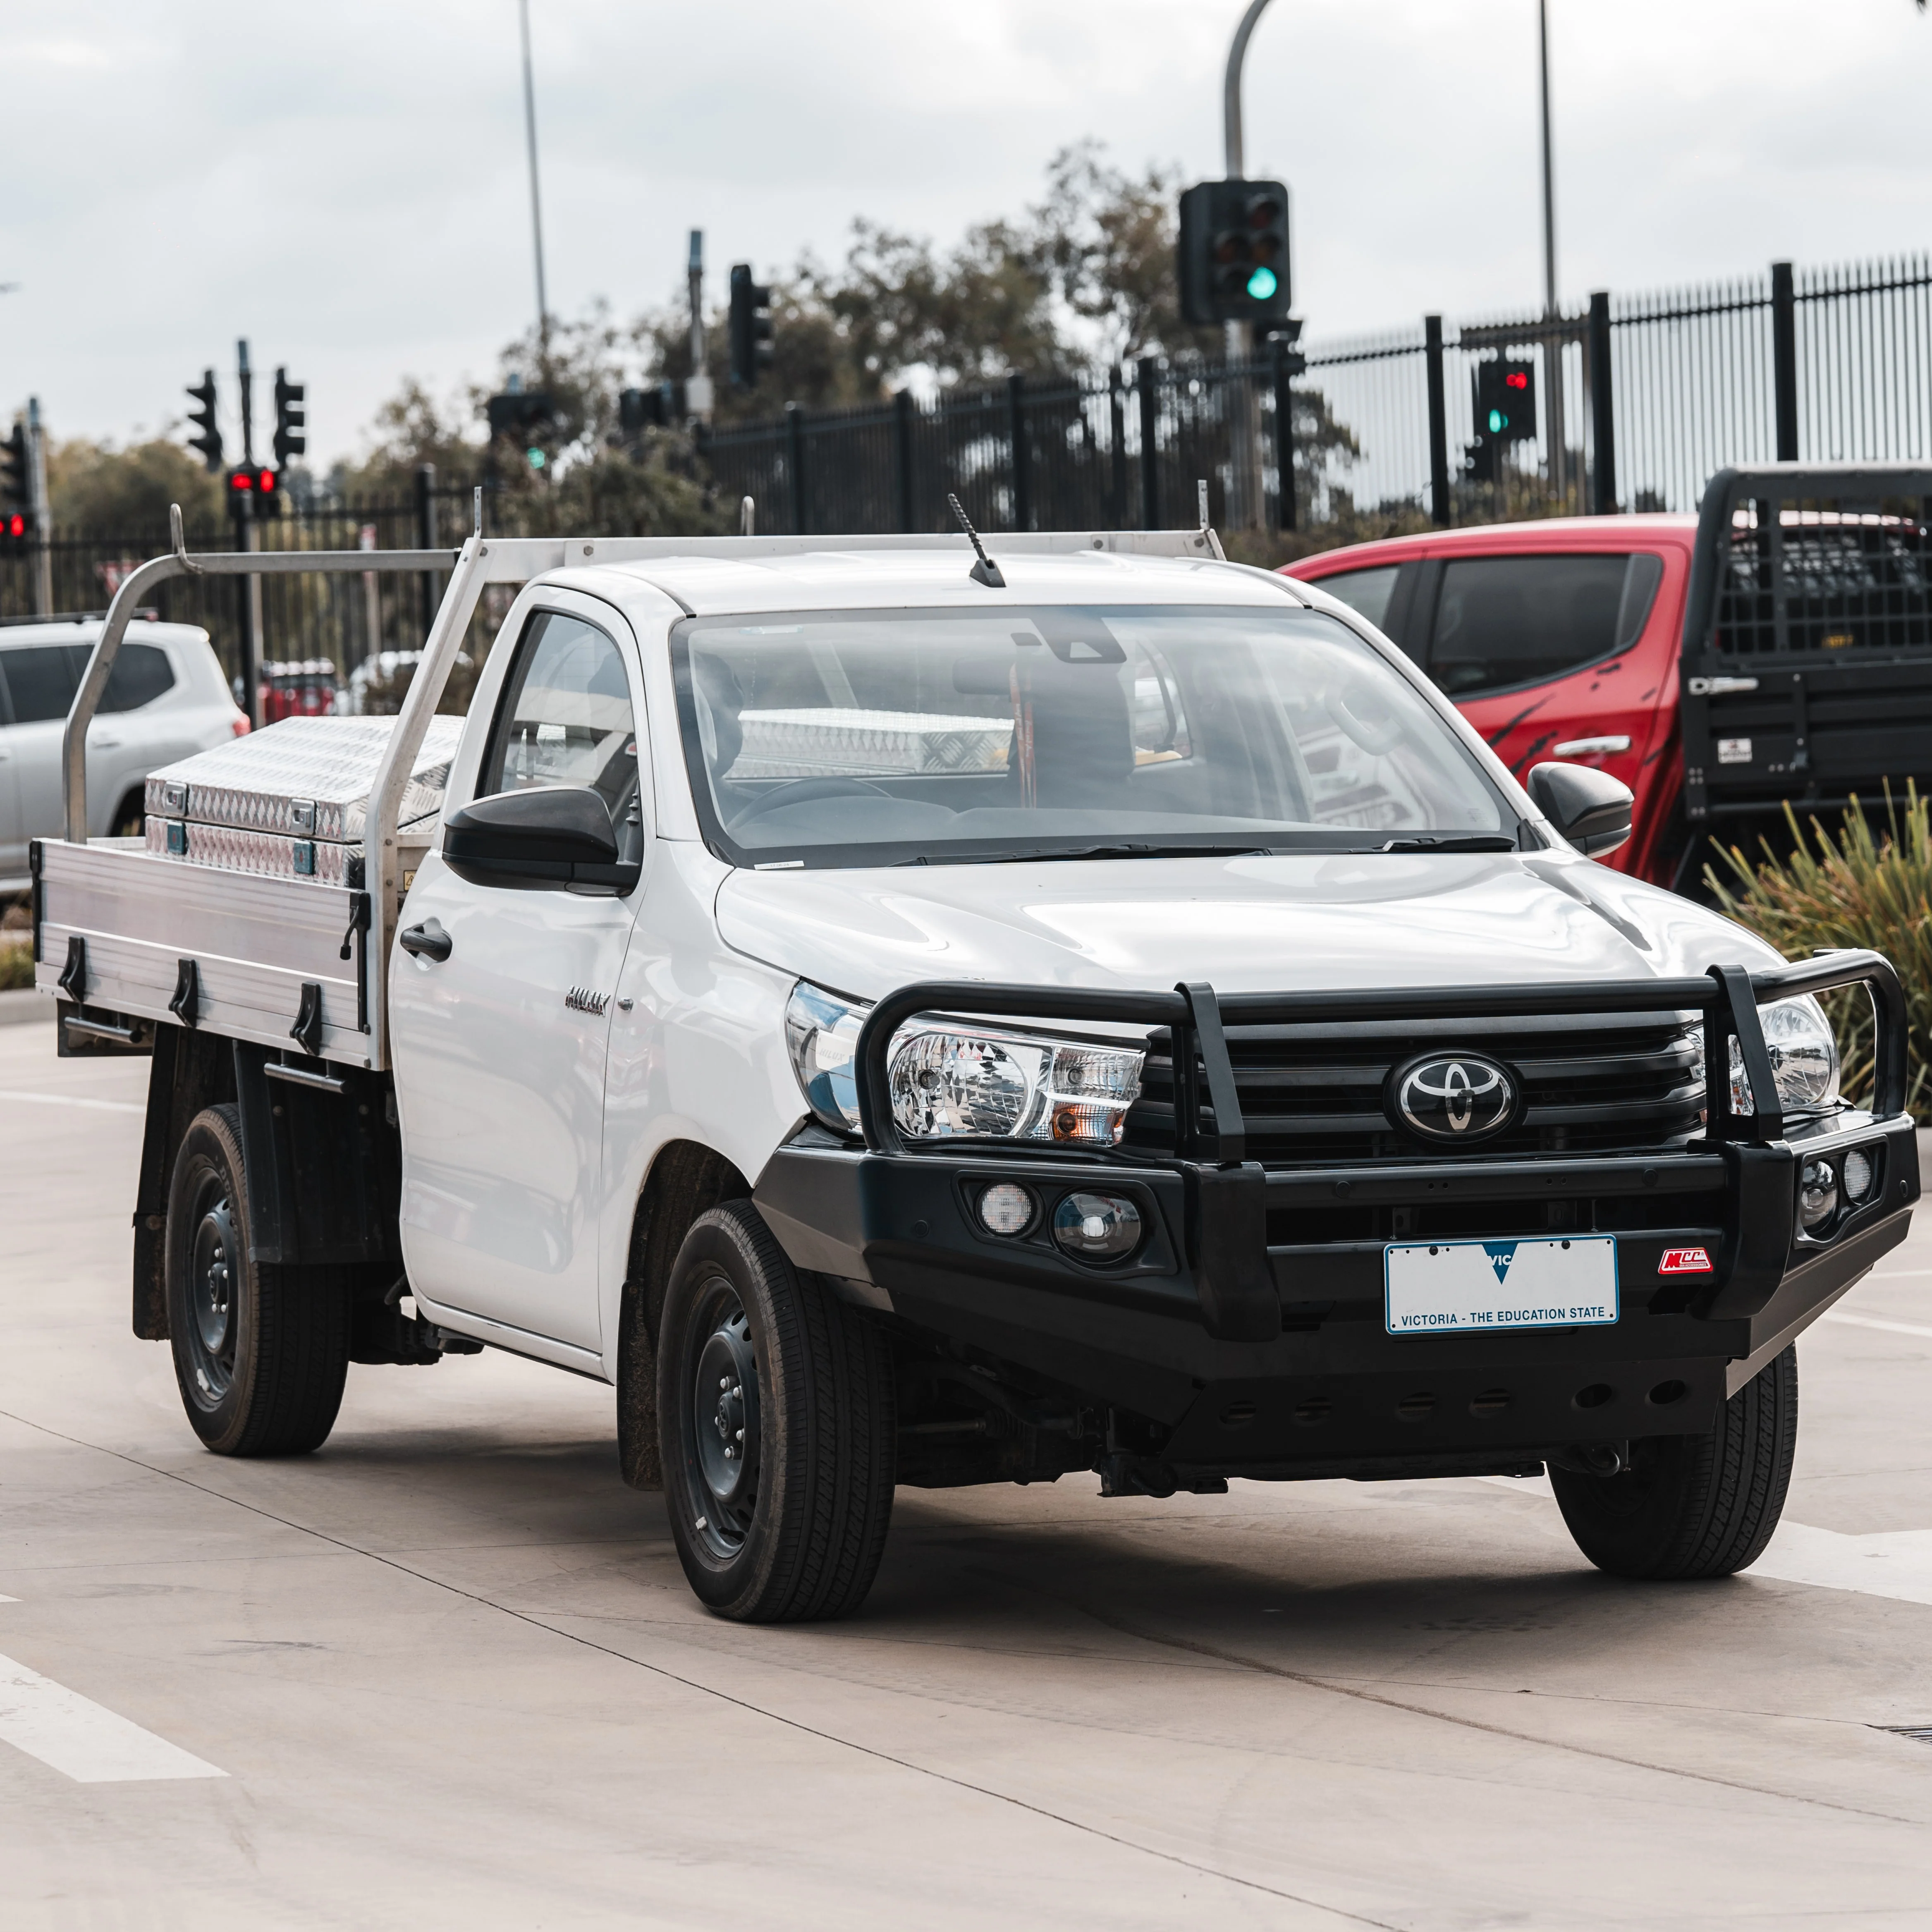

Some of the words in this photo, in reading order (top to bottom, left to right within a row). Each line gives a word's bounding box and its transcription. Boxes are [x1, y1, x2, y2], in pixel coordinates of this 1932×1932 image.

[565, 985, 611, 1018] HILUX
[819, 1048, 845, 1062] HILUX
[1487, 1254, 1512, 1266] VIC
[1401, 1313, 1458, 1326] VICTORIA
[1470, 1312, 1493, 1323] THE
[1497, 1308, 1566, 1322] EDUCATION
[1570, 1306, 1604, 1318] STATE
